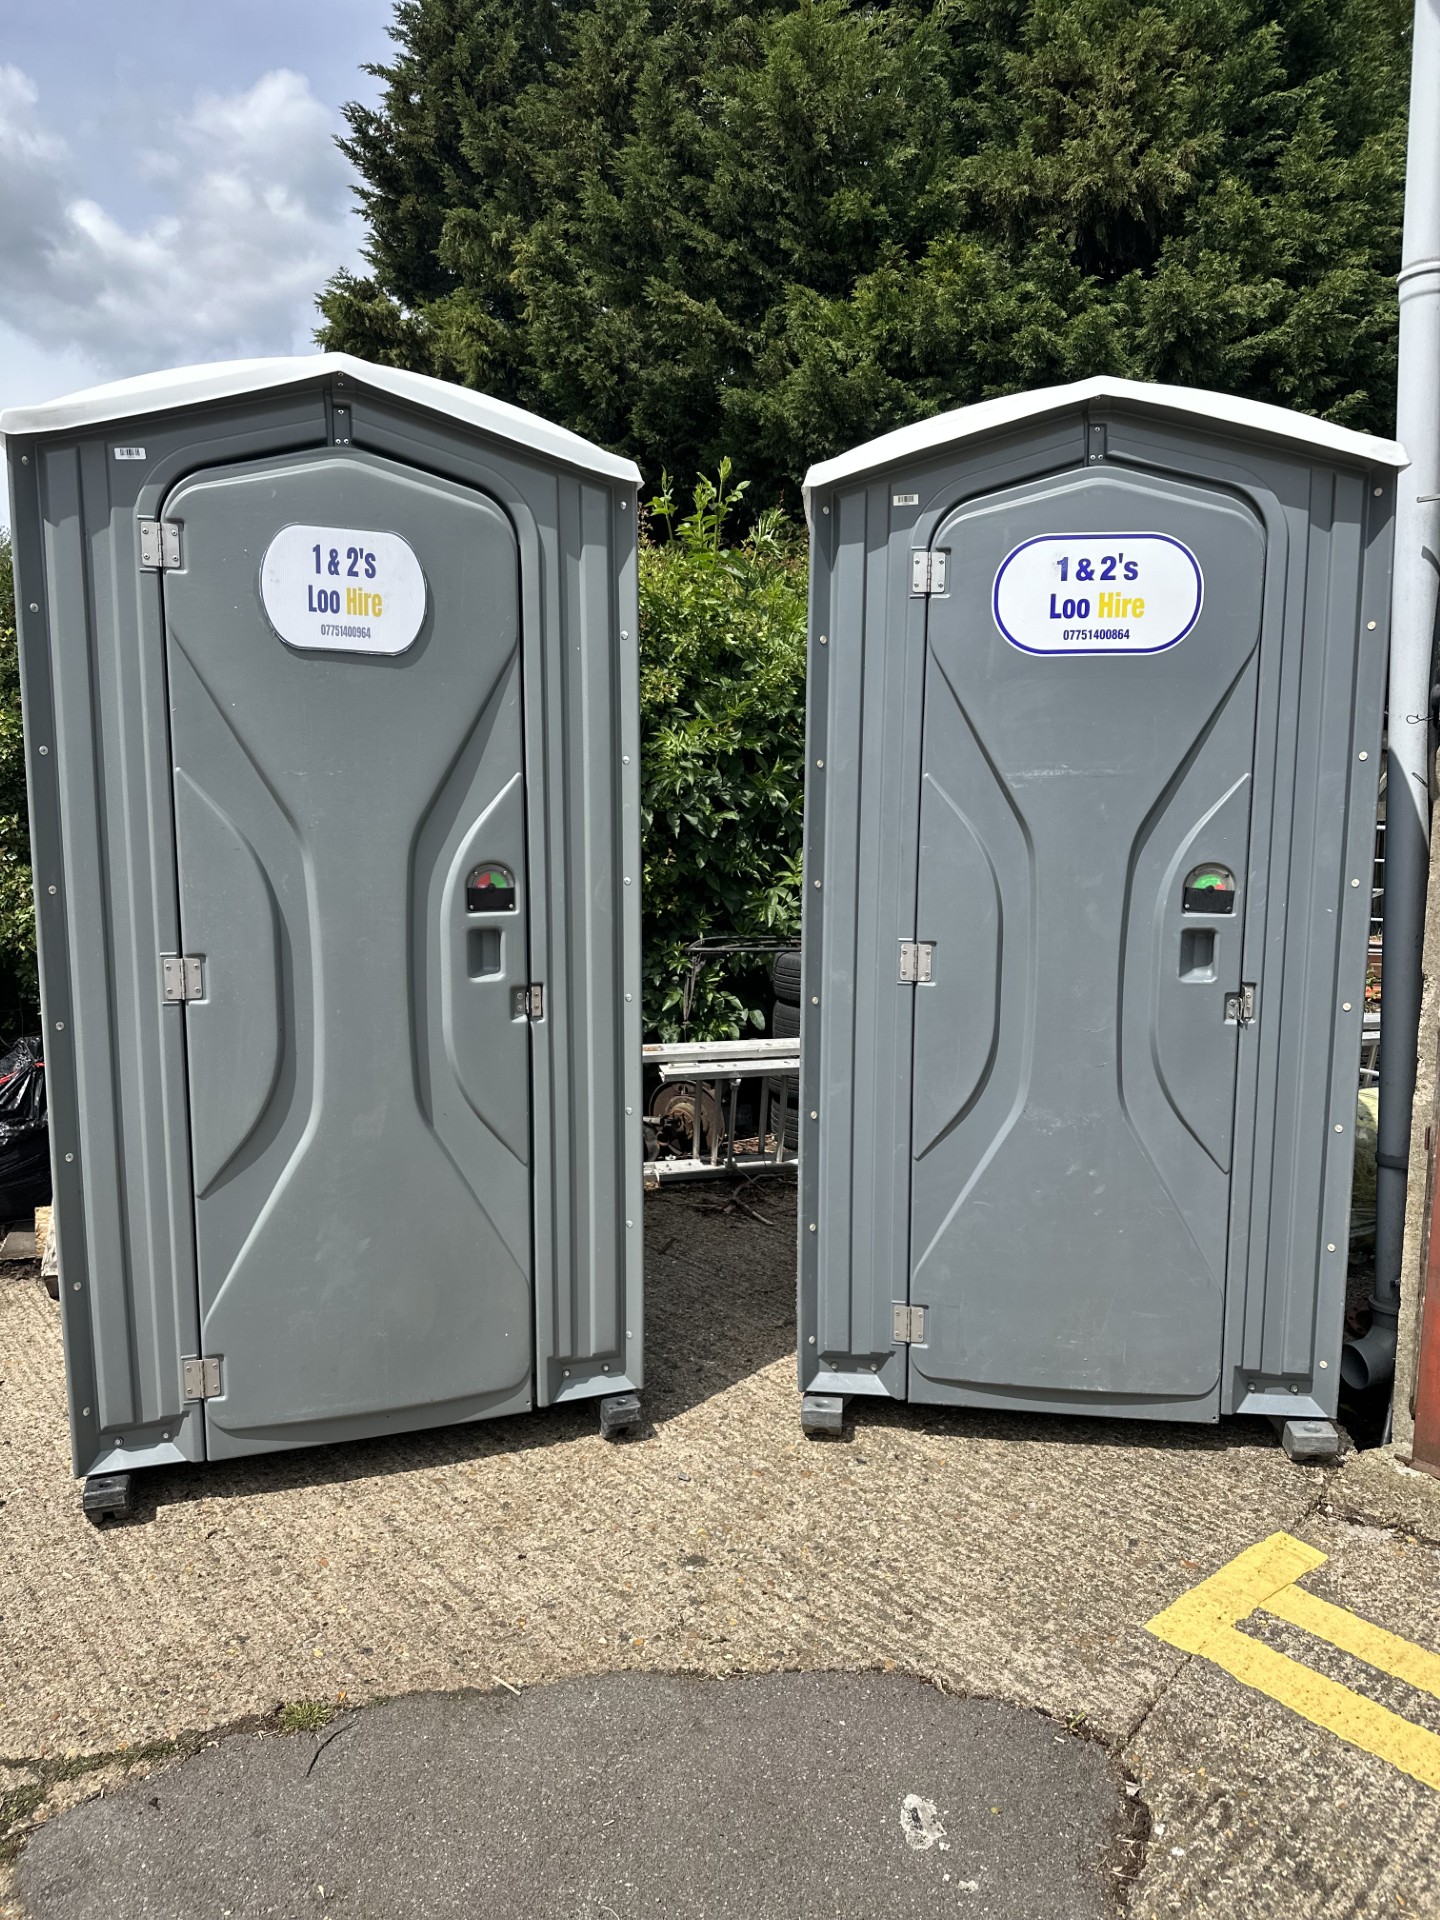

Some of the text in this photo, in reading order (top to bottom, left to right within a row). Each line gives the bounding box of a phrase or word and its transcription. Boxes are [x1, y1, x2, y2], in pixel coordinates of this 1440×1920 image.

[312, 544, 322, 575] 1
[327, 548, 341, 576] &
[1056, 552, 1139, 582] 1 & 2's
[308, 584, 383, 618] Loo Hire
[1049, 591, 1146, 620] Loo Hire
[1062, 628, 1131, 641] 07751400864
